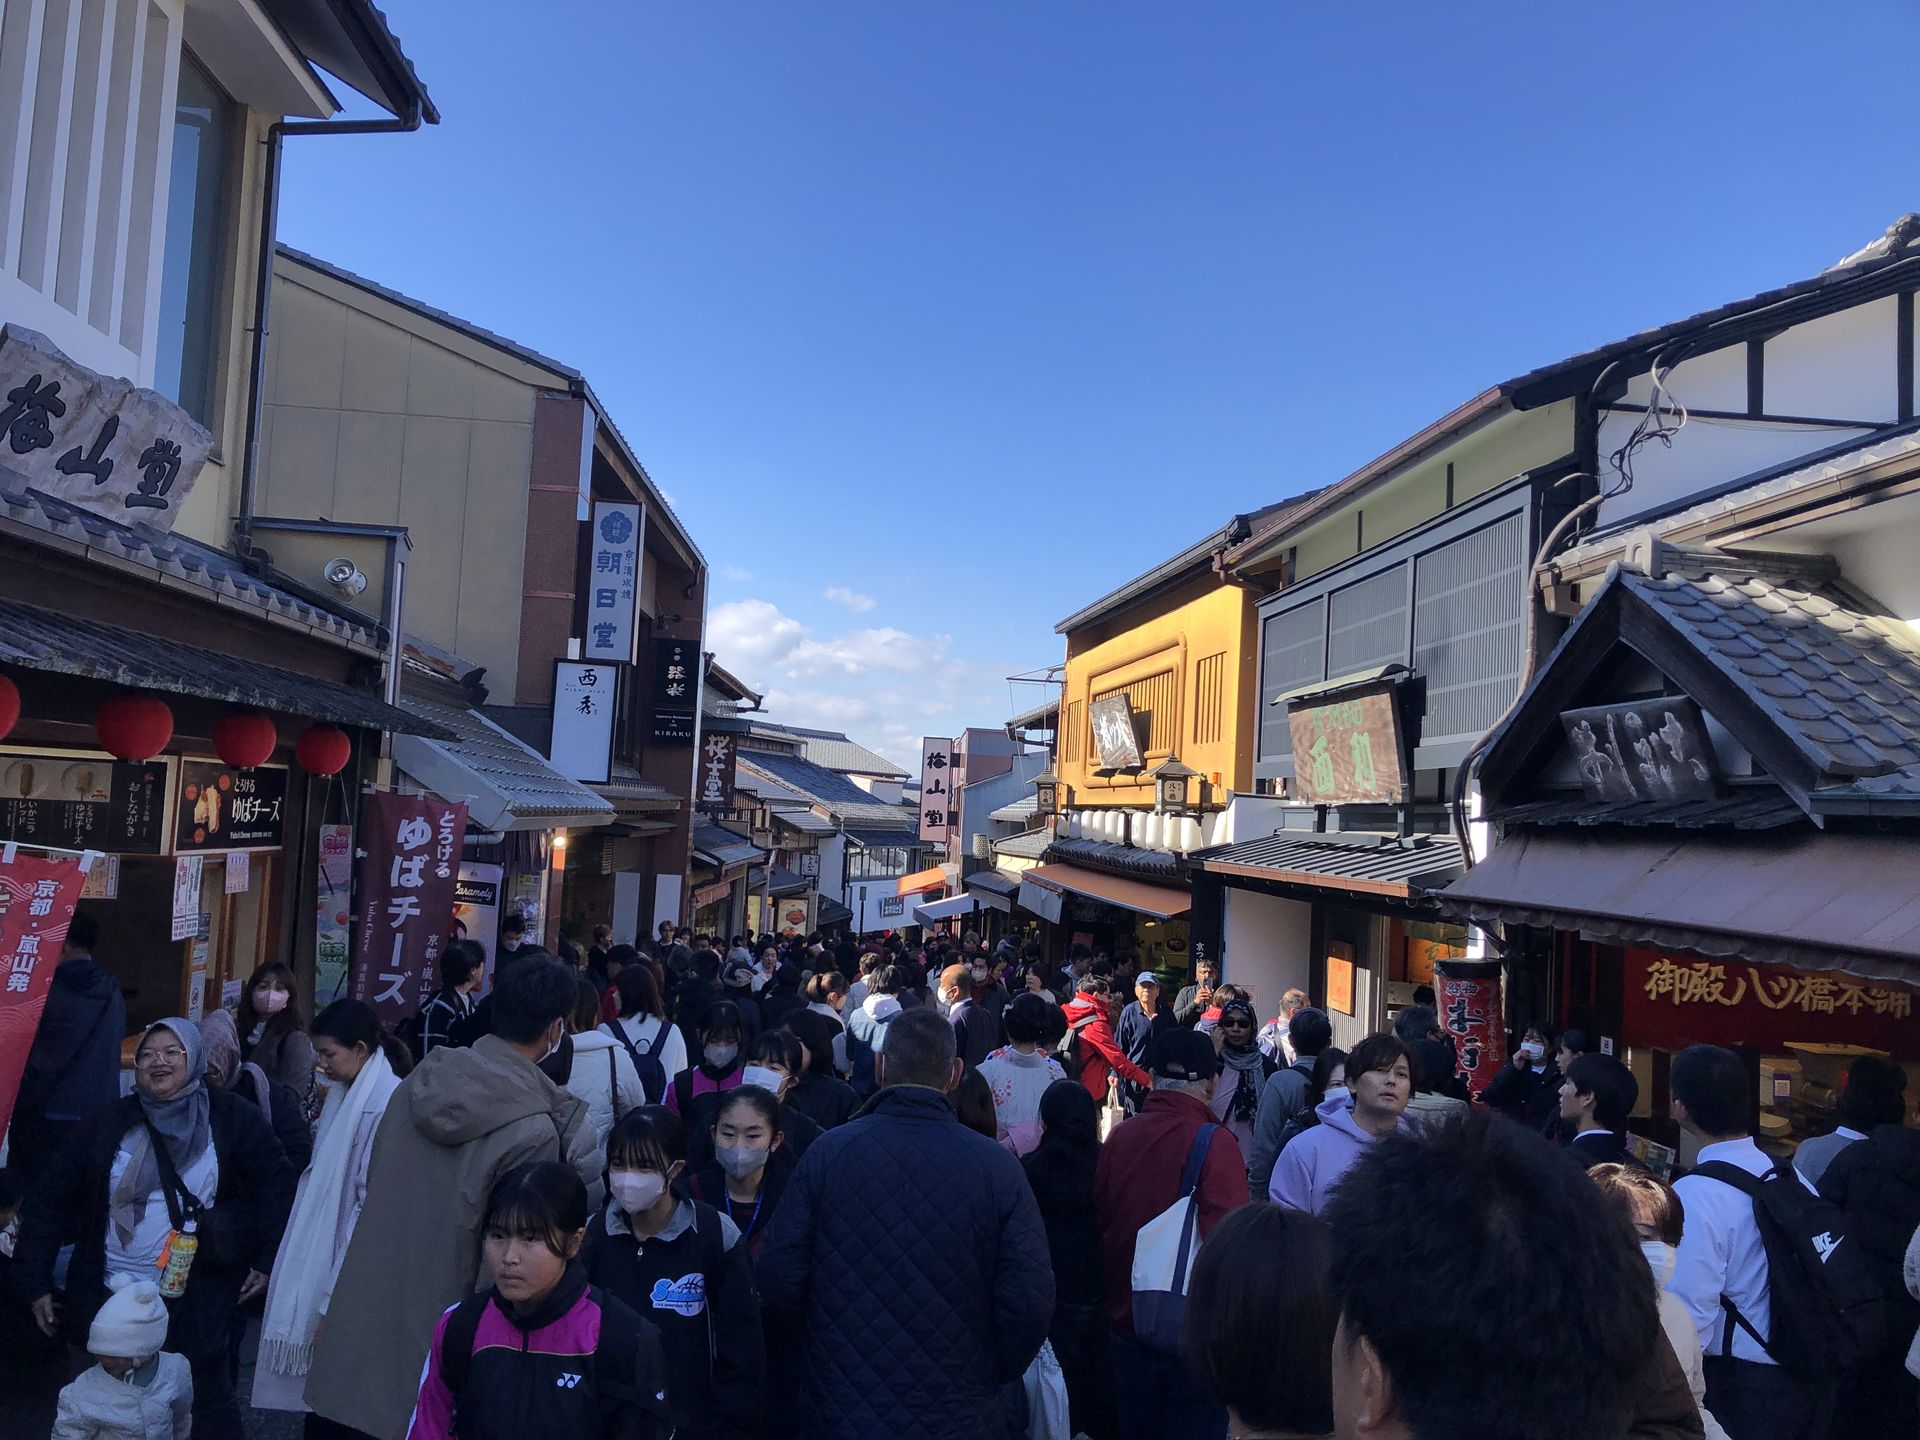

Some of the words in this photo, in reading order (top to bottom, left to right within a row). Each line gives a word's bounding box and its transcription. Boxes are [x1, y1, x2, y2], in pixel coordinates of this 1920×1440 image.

[593, 550, 622, 648] 朝日堂
[576, 668, 598, 715] 西秀
[73, 804, 86, 845] ゆばチーズ
[126, 782, 141, 837] おしながき
[232, 795, 282, 824] ゆばチーズ
[434, 810, 456, 879] とろける
[7, 879, 59, 992] 京都・嵐山発
[374, 815, 433, 1006] ゆばチーズ
